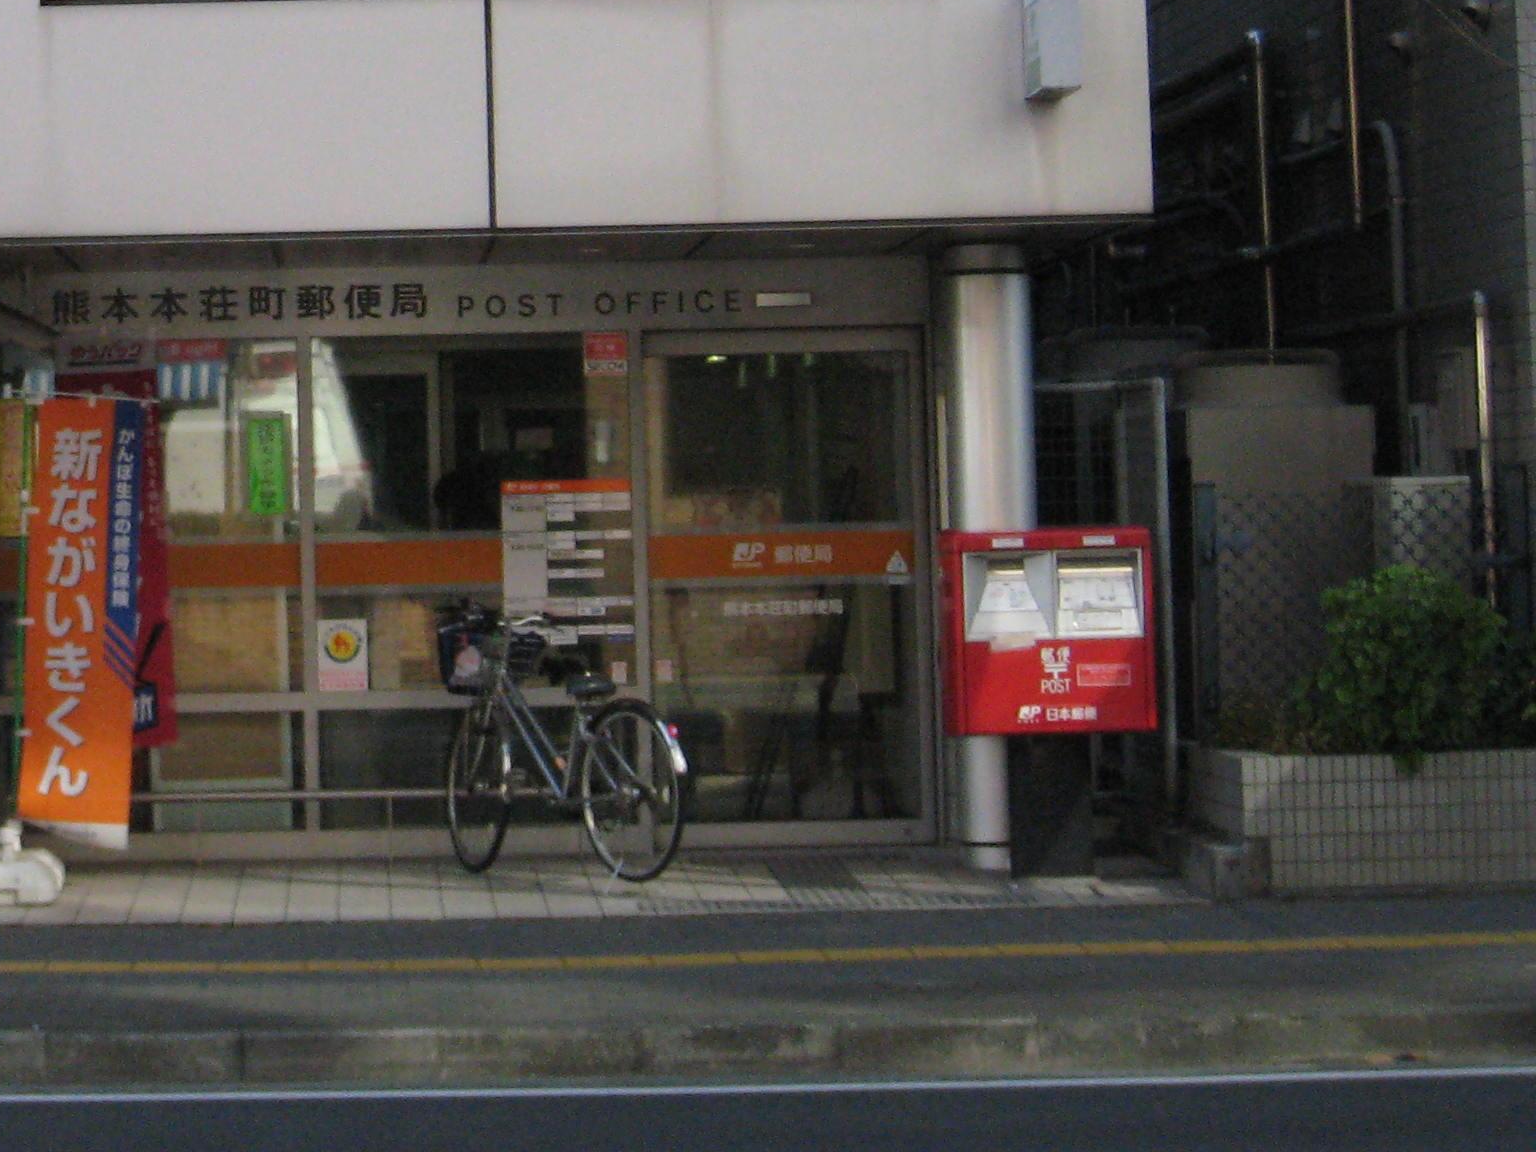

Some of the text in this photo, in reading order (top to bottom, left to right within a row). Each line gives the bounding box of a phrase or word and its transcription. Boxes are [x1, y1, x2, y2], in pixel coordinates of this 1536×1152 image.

[52, 282, 428, 325] 熊本本荘町郵便局
[456, 289, 742, 319] POST OFFICE
[37, 427, 103, 798] 新ながいきくん
[1040, 678, 1072, 695] POST
